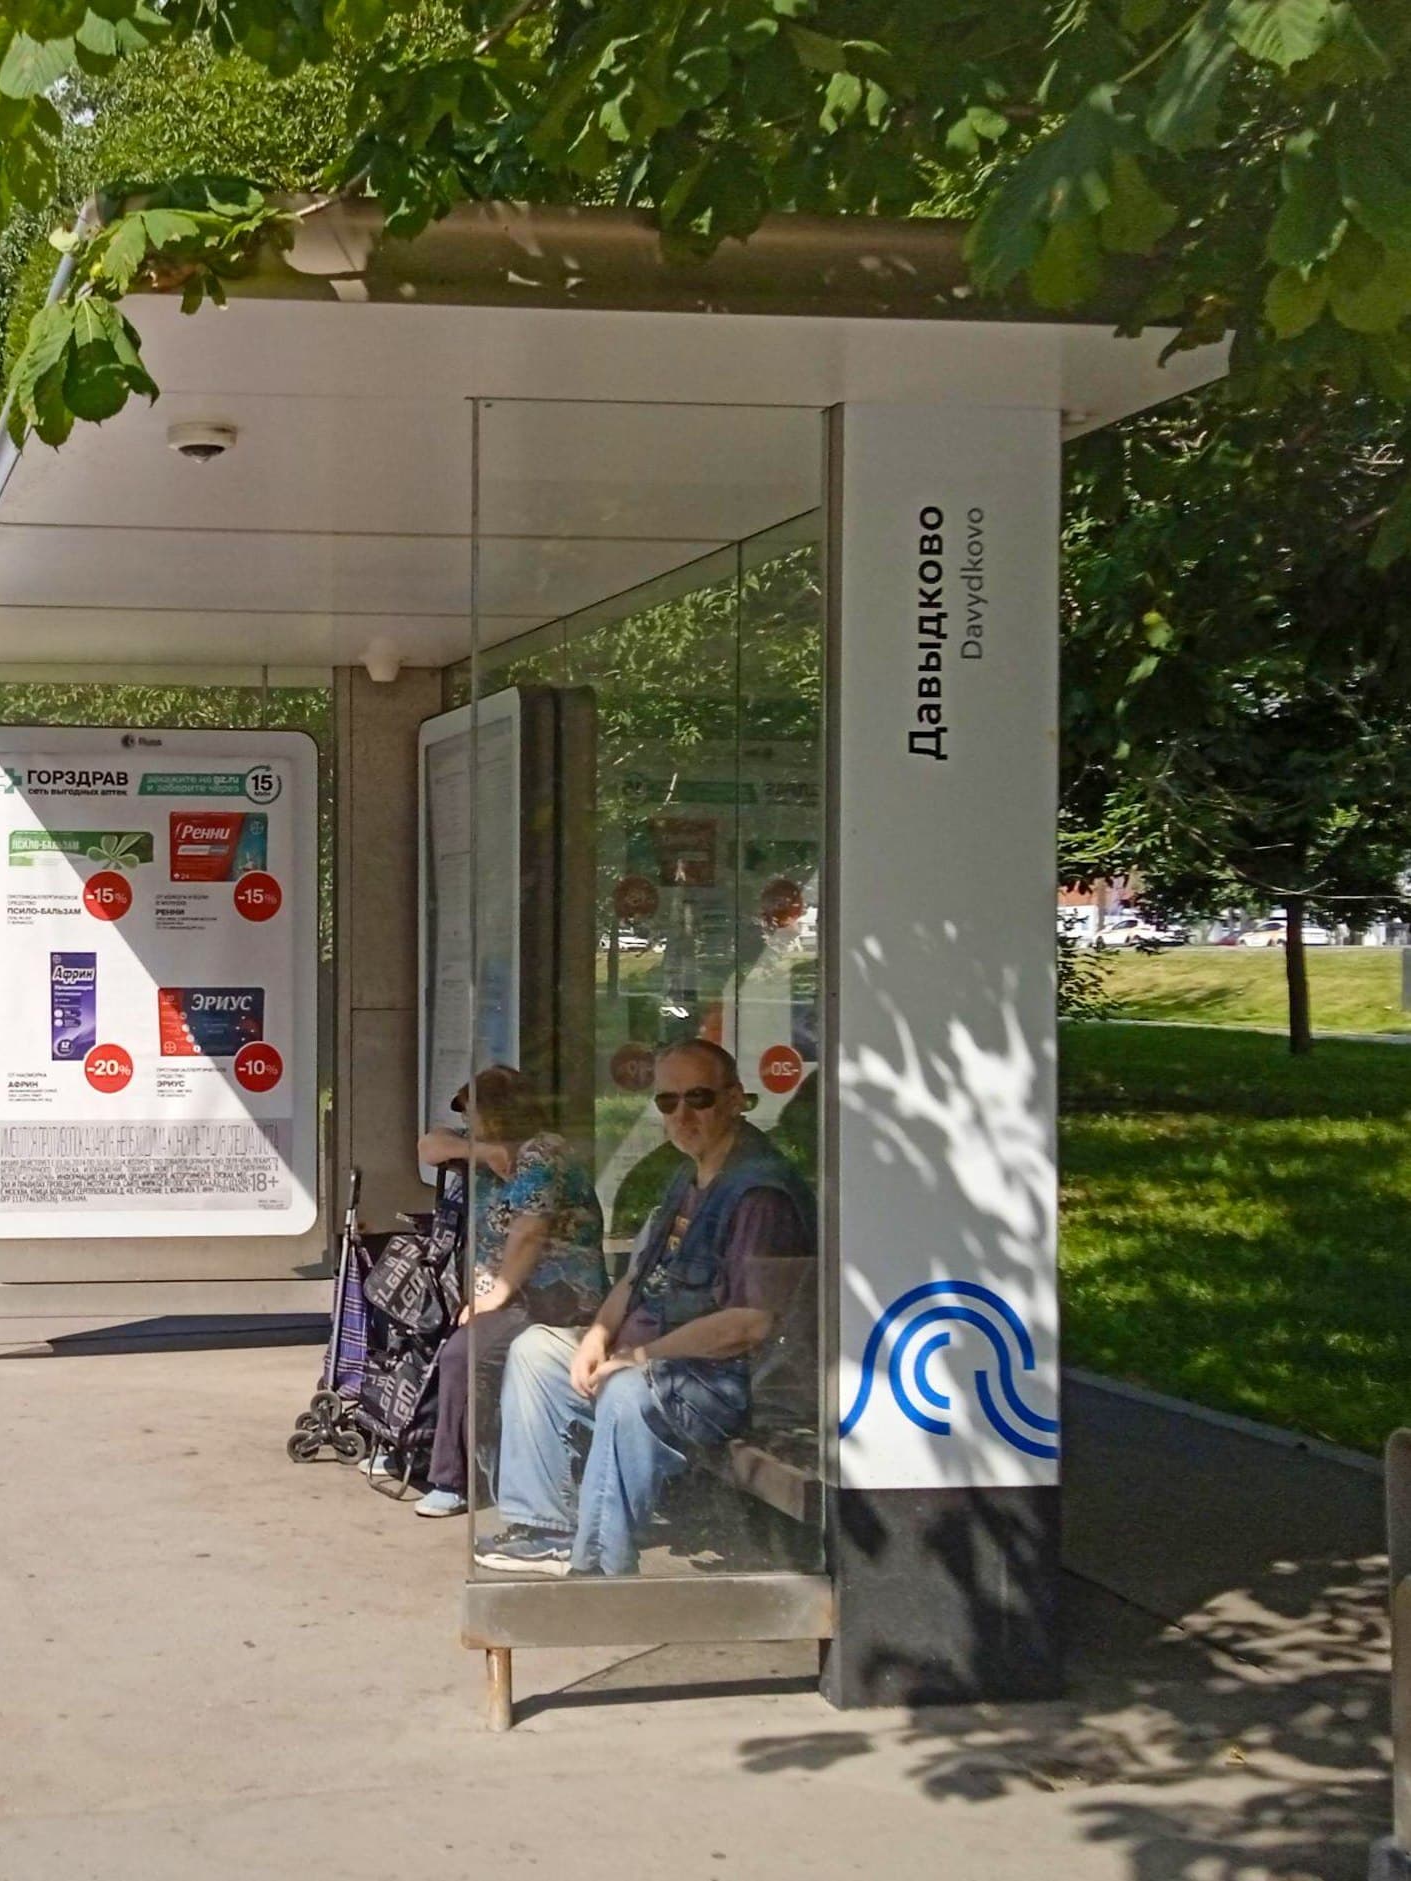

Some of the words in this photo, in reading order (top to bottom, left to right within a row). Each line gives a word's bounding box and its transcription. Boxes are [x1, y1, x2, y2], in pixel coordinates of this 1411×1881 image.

[960, 507, 989, 660] Davydkovo
[908, 505, 948, 761] Давыдково
[27, 770, 129, 787] ГОРЗДРАВ
[251, 775, 273, 791] 15
[51, 788, 99, 797] выгодных
[181, 824, 230, 840] Ренни
[85, 888, 128, 904] -15%
[7, 907, 81, 915] ПСИЛО-БАЛЬЗАМ
[53, 966, 94, 984] Африн
[191, 993, 253, 1011] ЭРИУС
[86, 1059, 132, 1076] -20%
[237, 1059, 279, 1076] -10%
[251, 1172, 279, 1193] 18+
